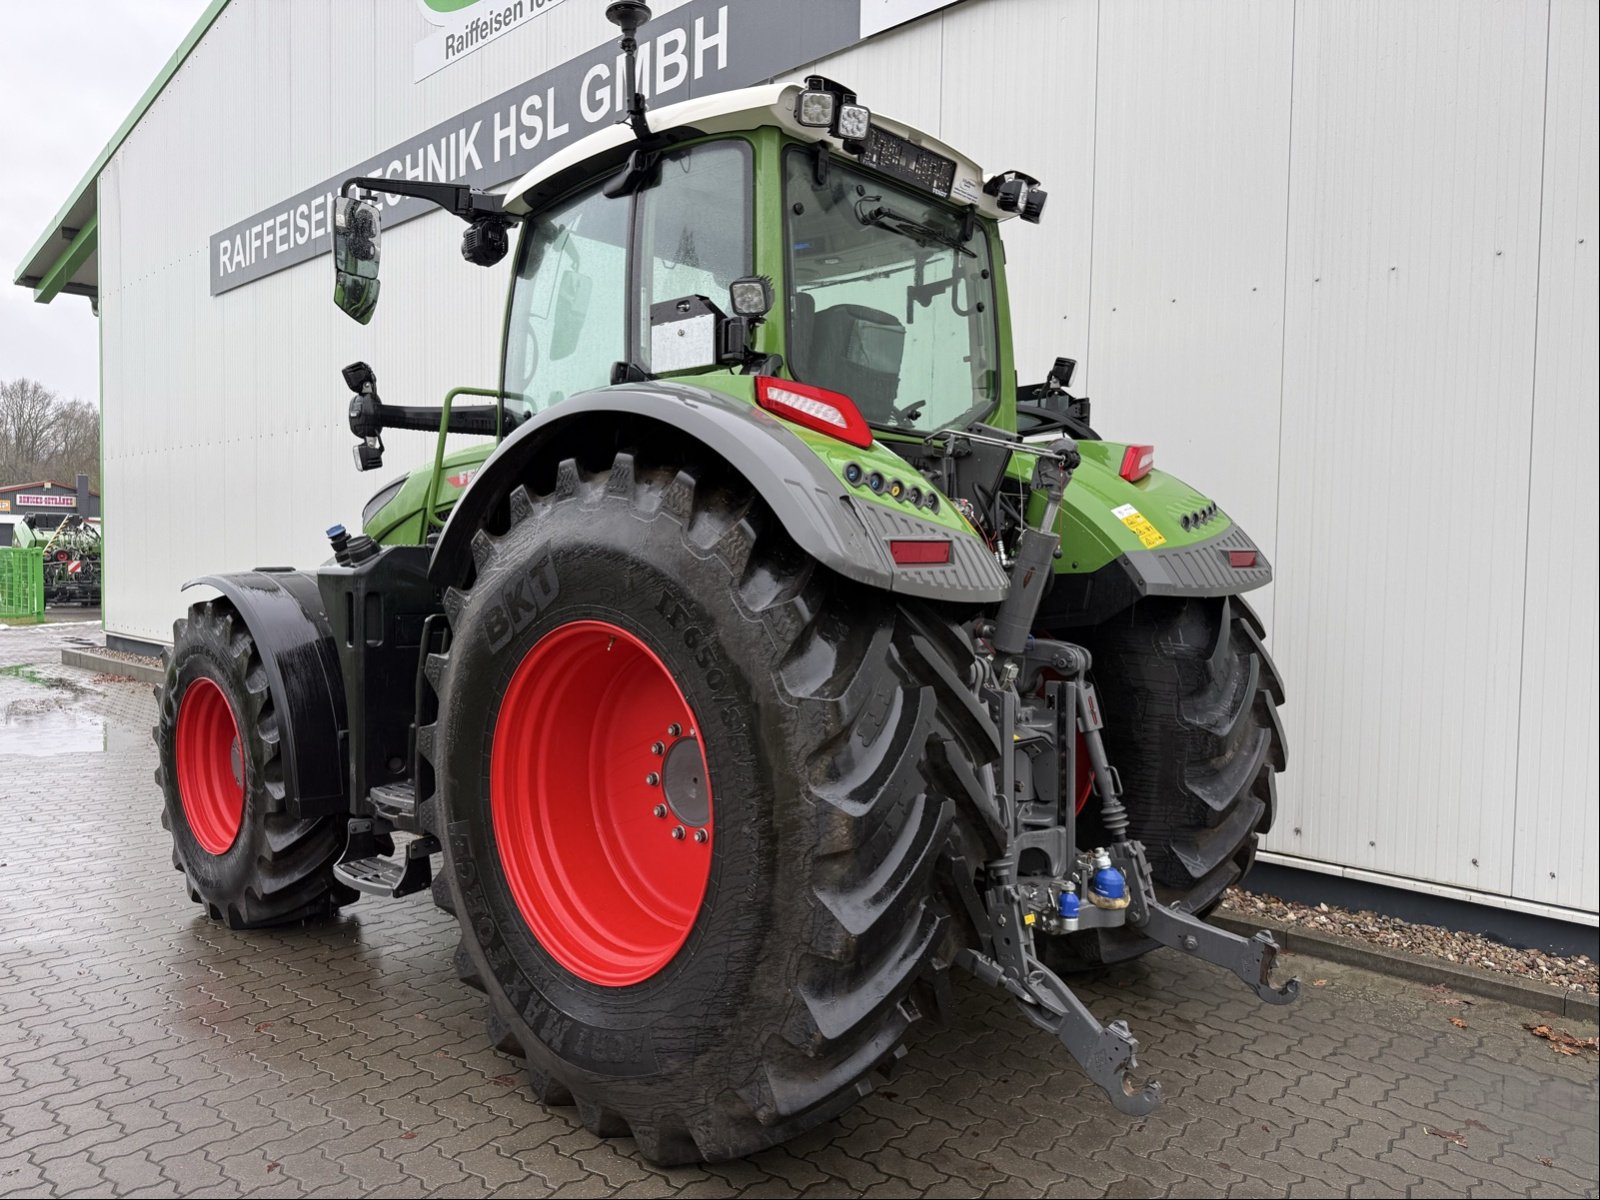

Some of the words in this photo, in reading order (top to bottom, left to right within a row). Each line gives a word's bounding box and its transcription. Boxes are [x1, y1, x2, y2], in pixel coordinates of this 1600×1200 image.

[445, 3, 523, 60] Raiffeisen
[494, 87, 569, 163] HSL
[580, 5, 728, 123] GMBH
[482, 545, 556, 650] BKT
